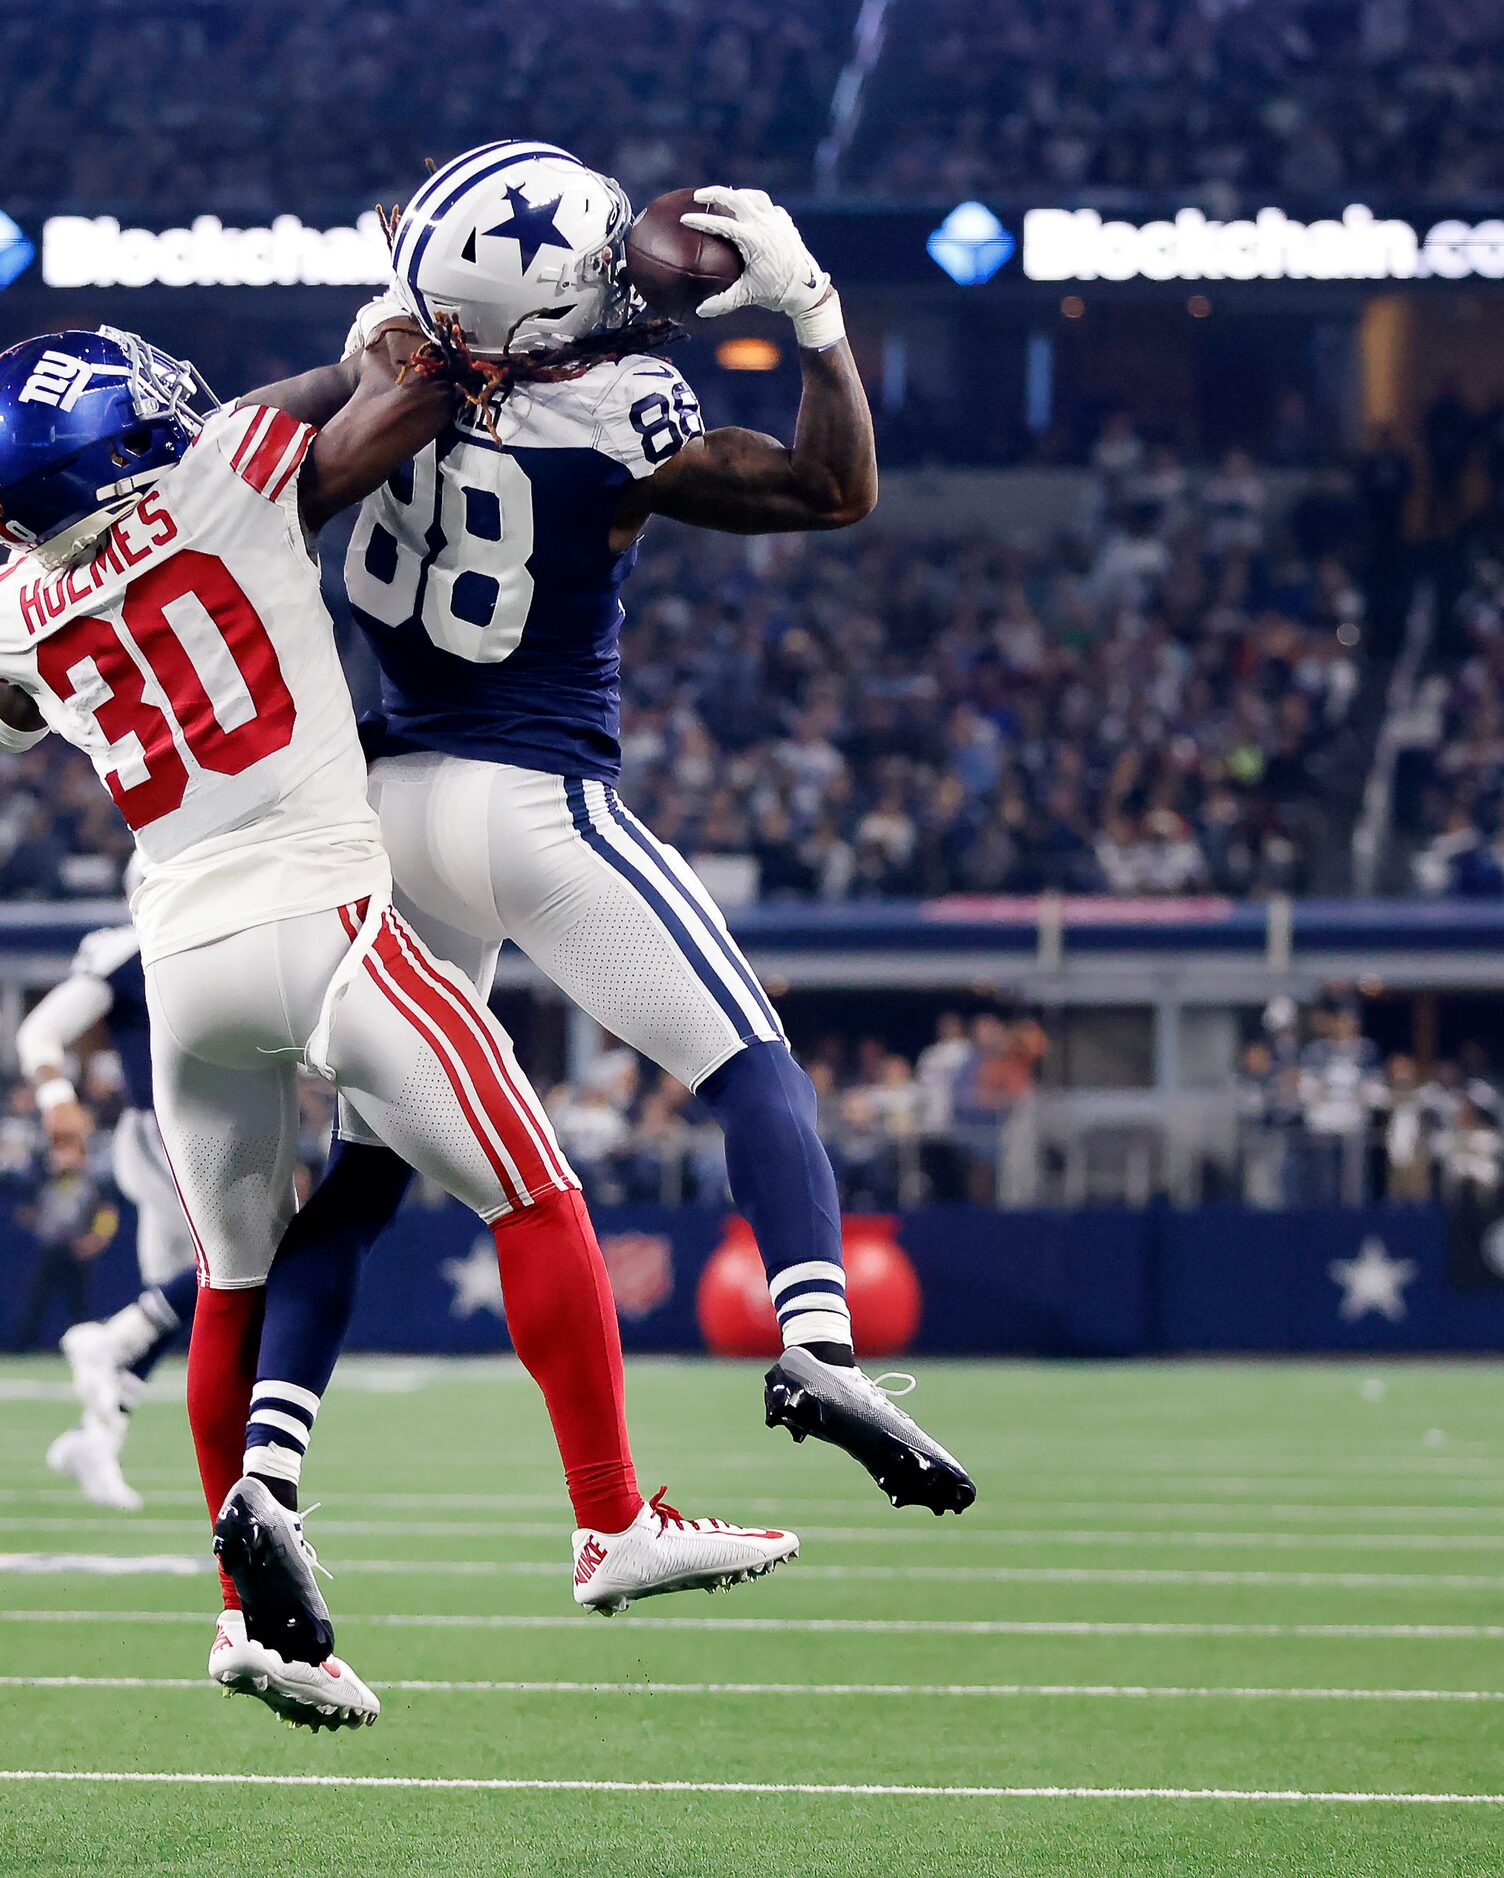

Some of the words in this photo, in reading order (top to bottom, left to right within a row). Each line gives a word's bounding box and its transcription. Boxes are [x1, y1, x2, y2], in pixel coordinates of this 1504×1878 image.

[43, 214, 394, 288] Blockchai
[628, 381, 704, 465] 88
[19, 490, 178, 636] HOLMES
[344, 438, 534, 663] 88
[36, 548, 297, 831] 30
[575, 1534, 608, 1586] NIKE
